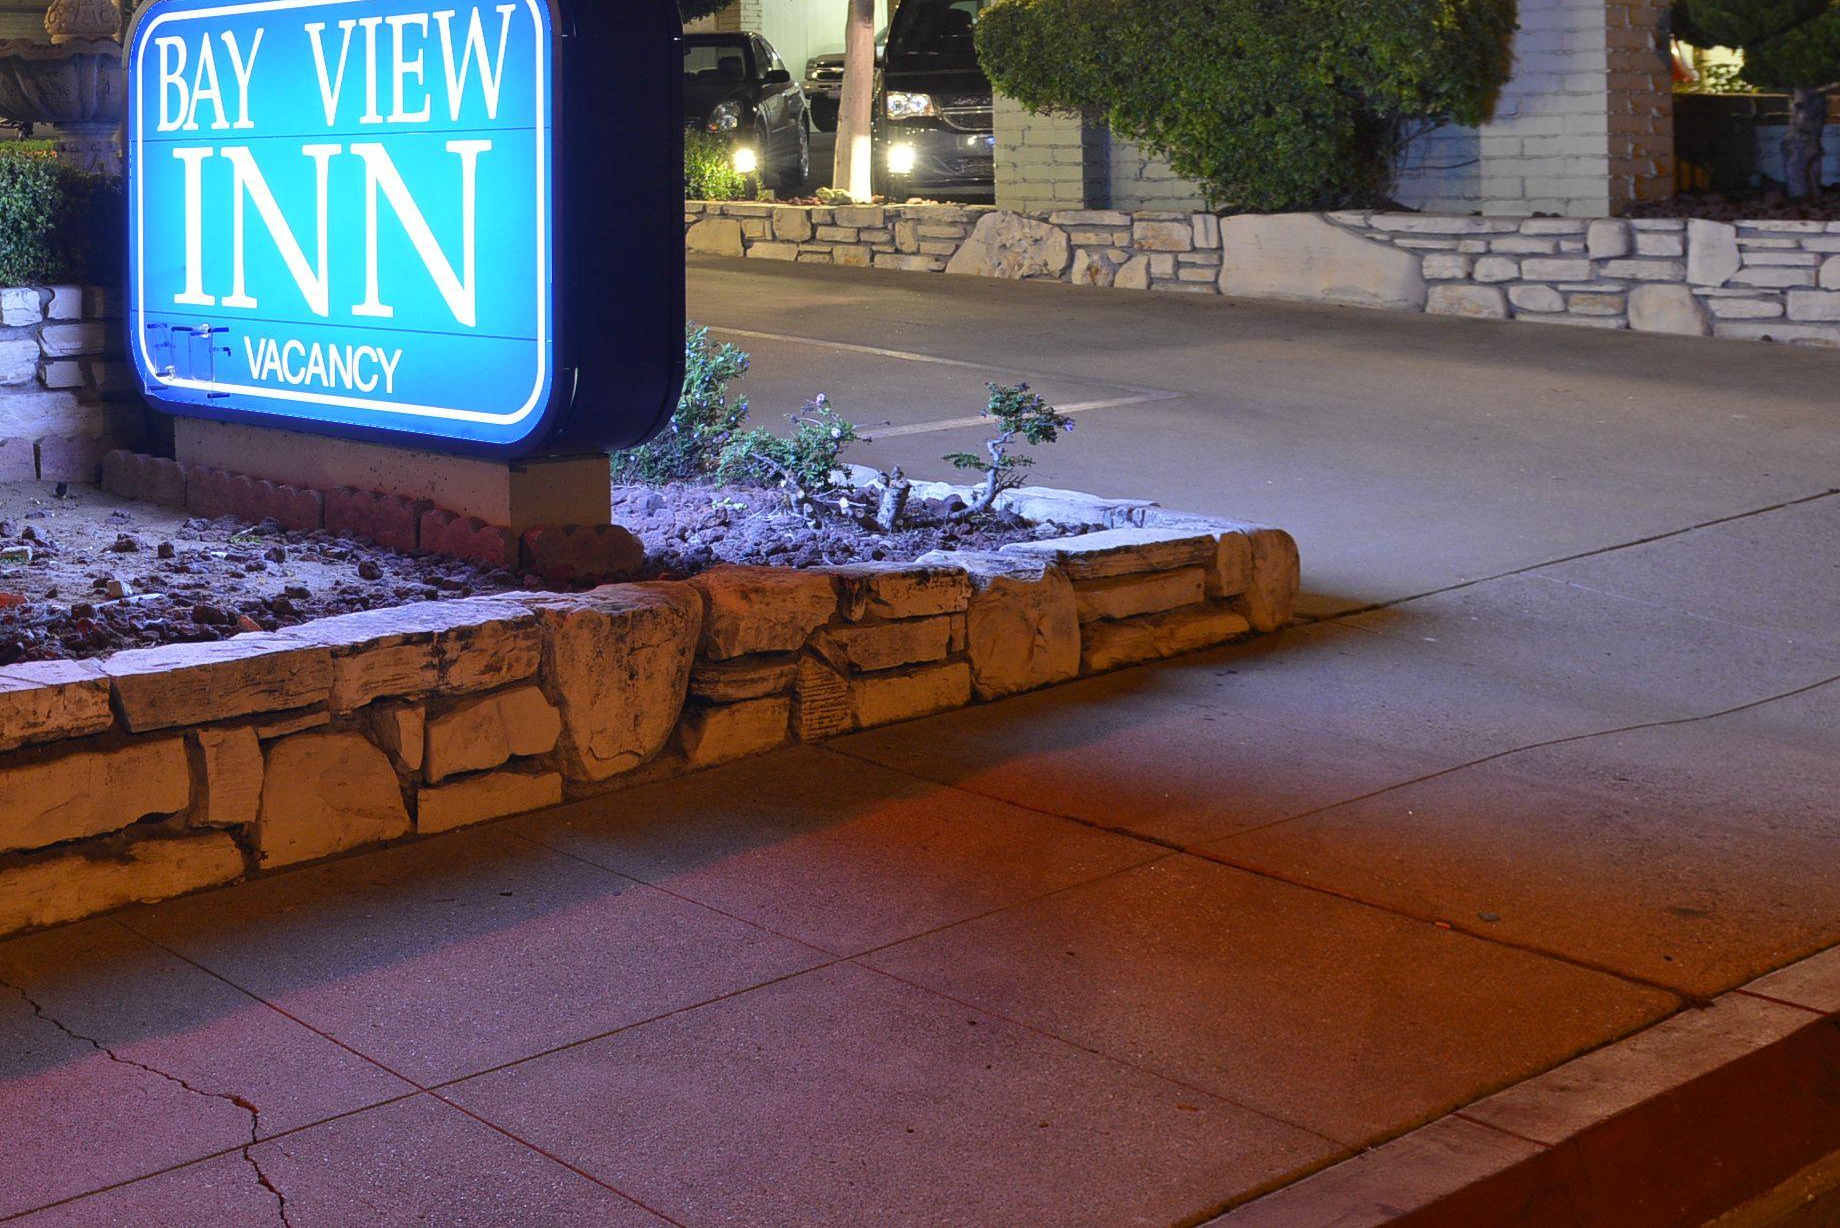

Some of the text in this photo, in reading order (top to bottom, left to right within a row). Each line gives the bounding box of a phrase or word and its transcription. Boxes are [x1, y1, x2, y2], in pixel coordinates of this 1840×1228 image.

[155, 3, 517, 132] BAY VIEW
[172, 139, 493, 328] INN
[243, 335, 403, 395] VACANCY
